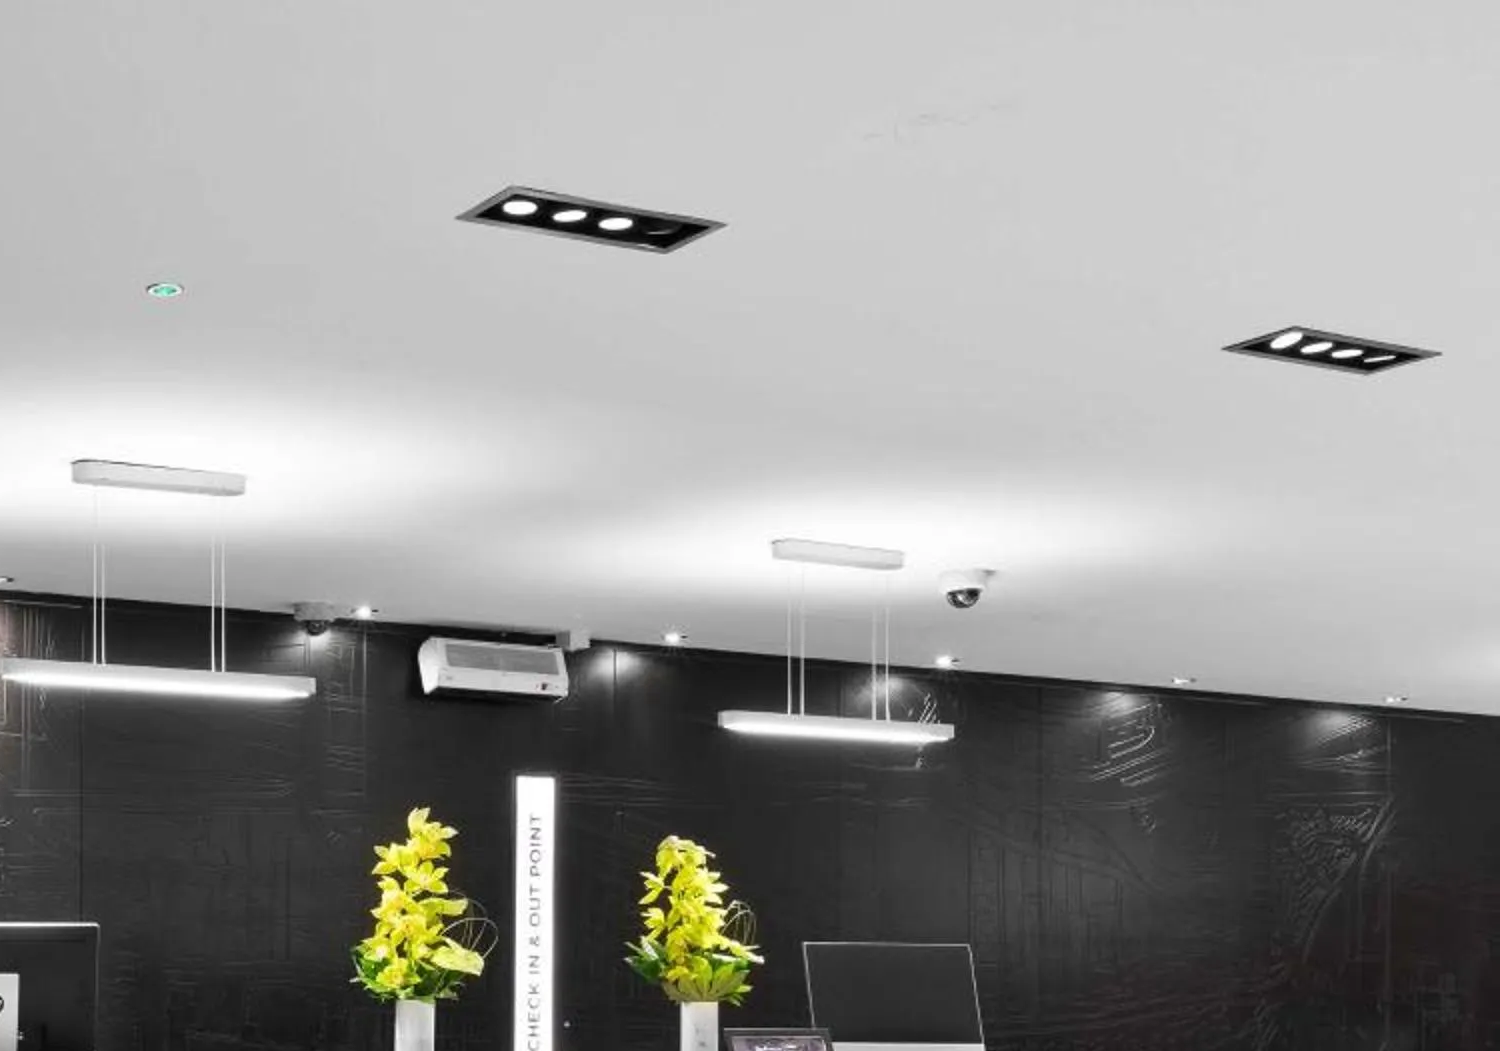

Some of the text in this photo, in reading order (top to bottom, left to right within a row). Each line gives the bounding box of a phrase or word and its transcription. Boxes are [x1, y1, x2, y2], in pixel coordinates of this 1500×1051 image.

[529, 814, 542, 878] POINT
[529, 883, 541, 928] OUT
[528, 935, 541, 948] &
[528, 955, 541, 975] IN
